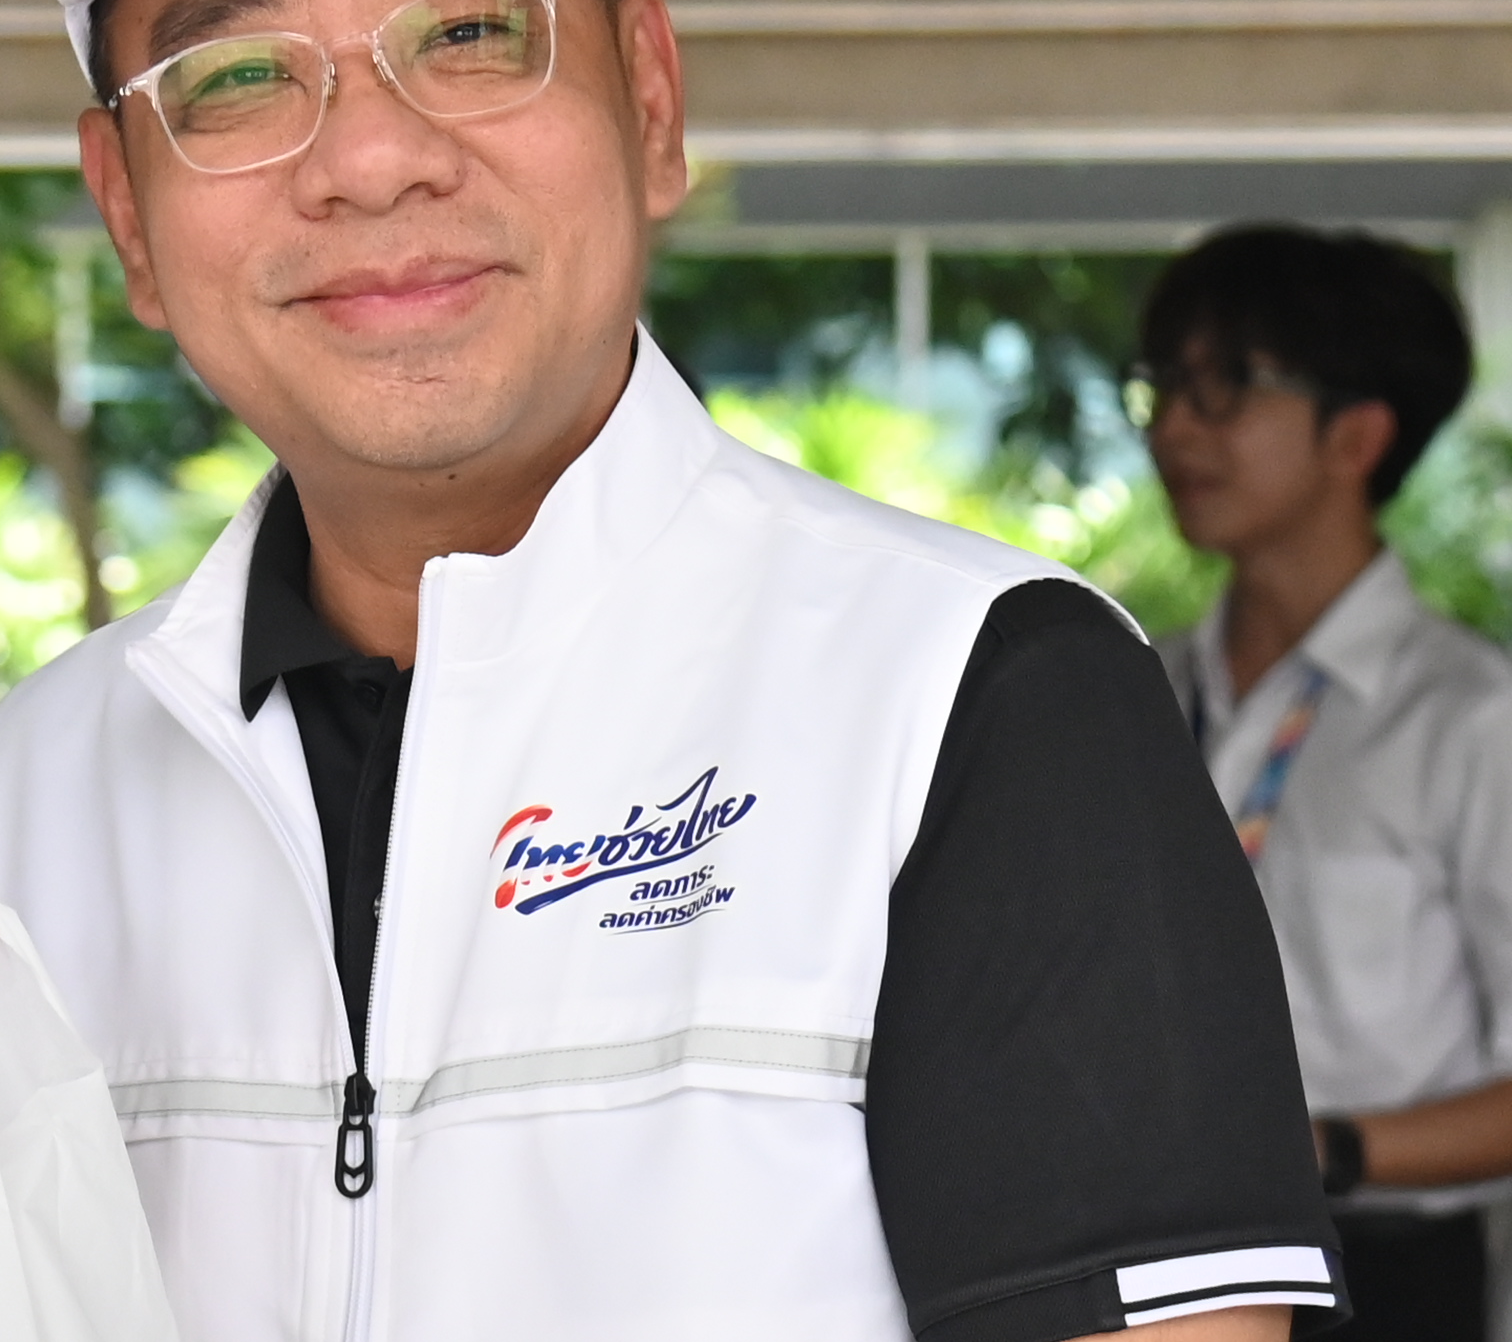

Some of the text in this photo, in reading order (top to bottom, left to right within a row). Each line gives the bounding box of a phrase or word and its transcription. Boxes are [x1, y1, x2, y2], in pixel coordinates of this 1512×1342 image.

[629, 864, 715, 901] ลดภาระ
[598, 884, 736, 929] ลดค่าครองชีพ
